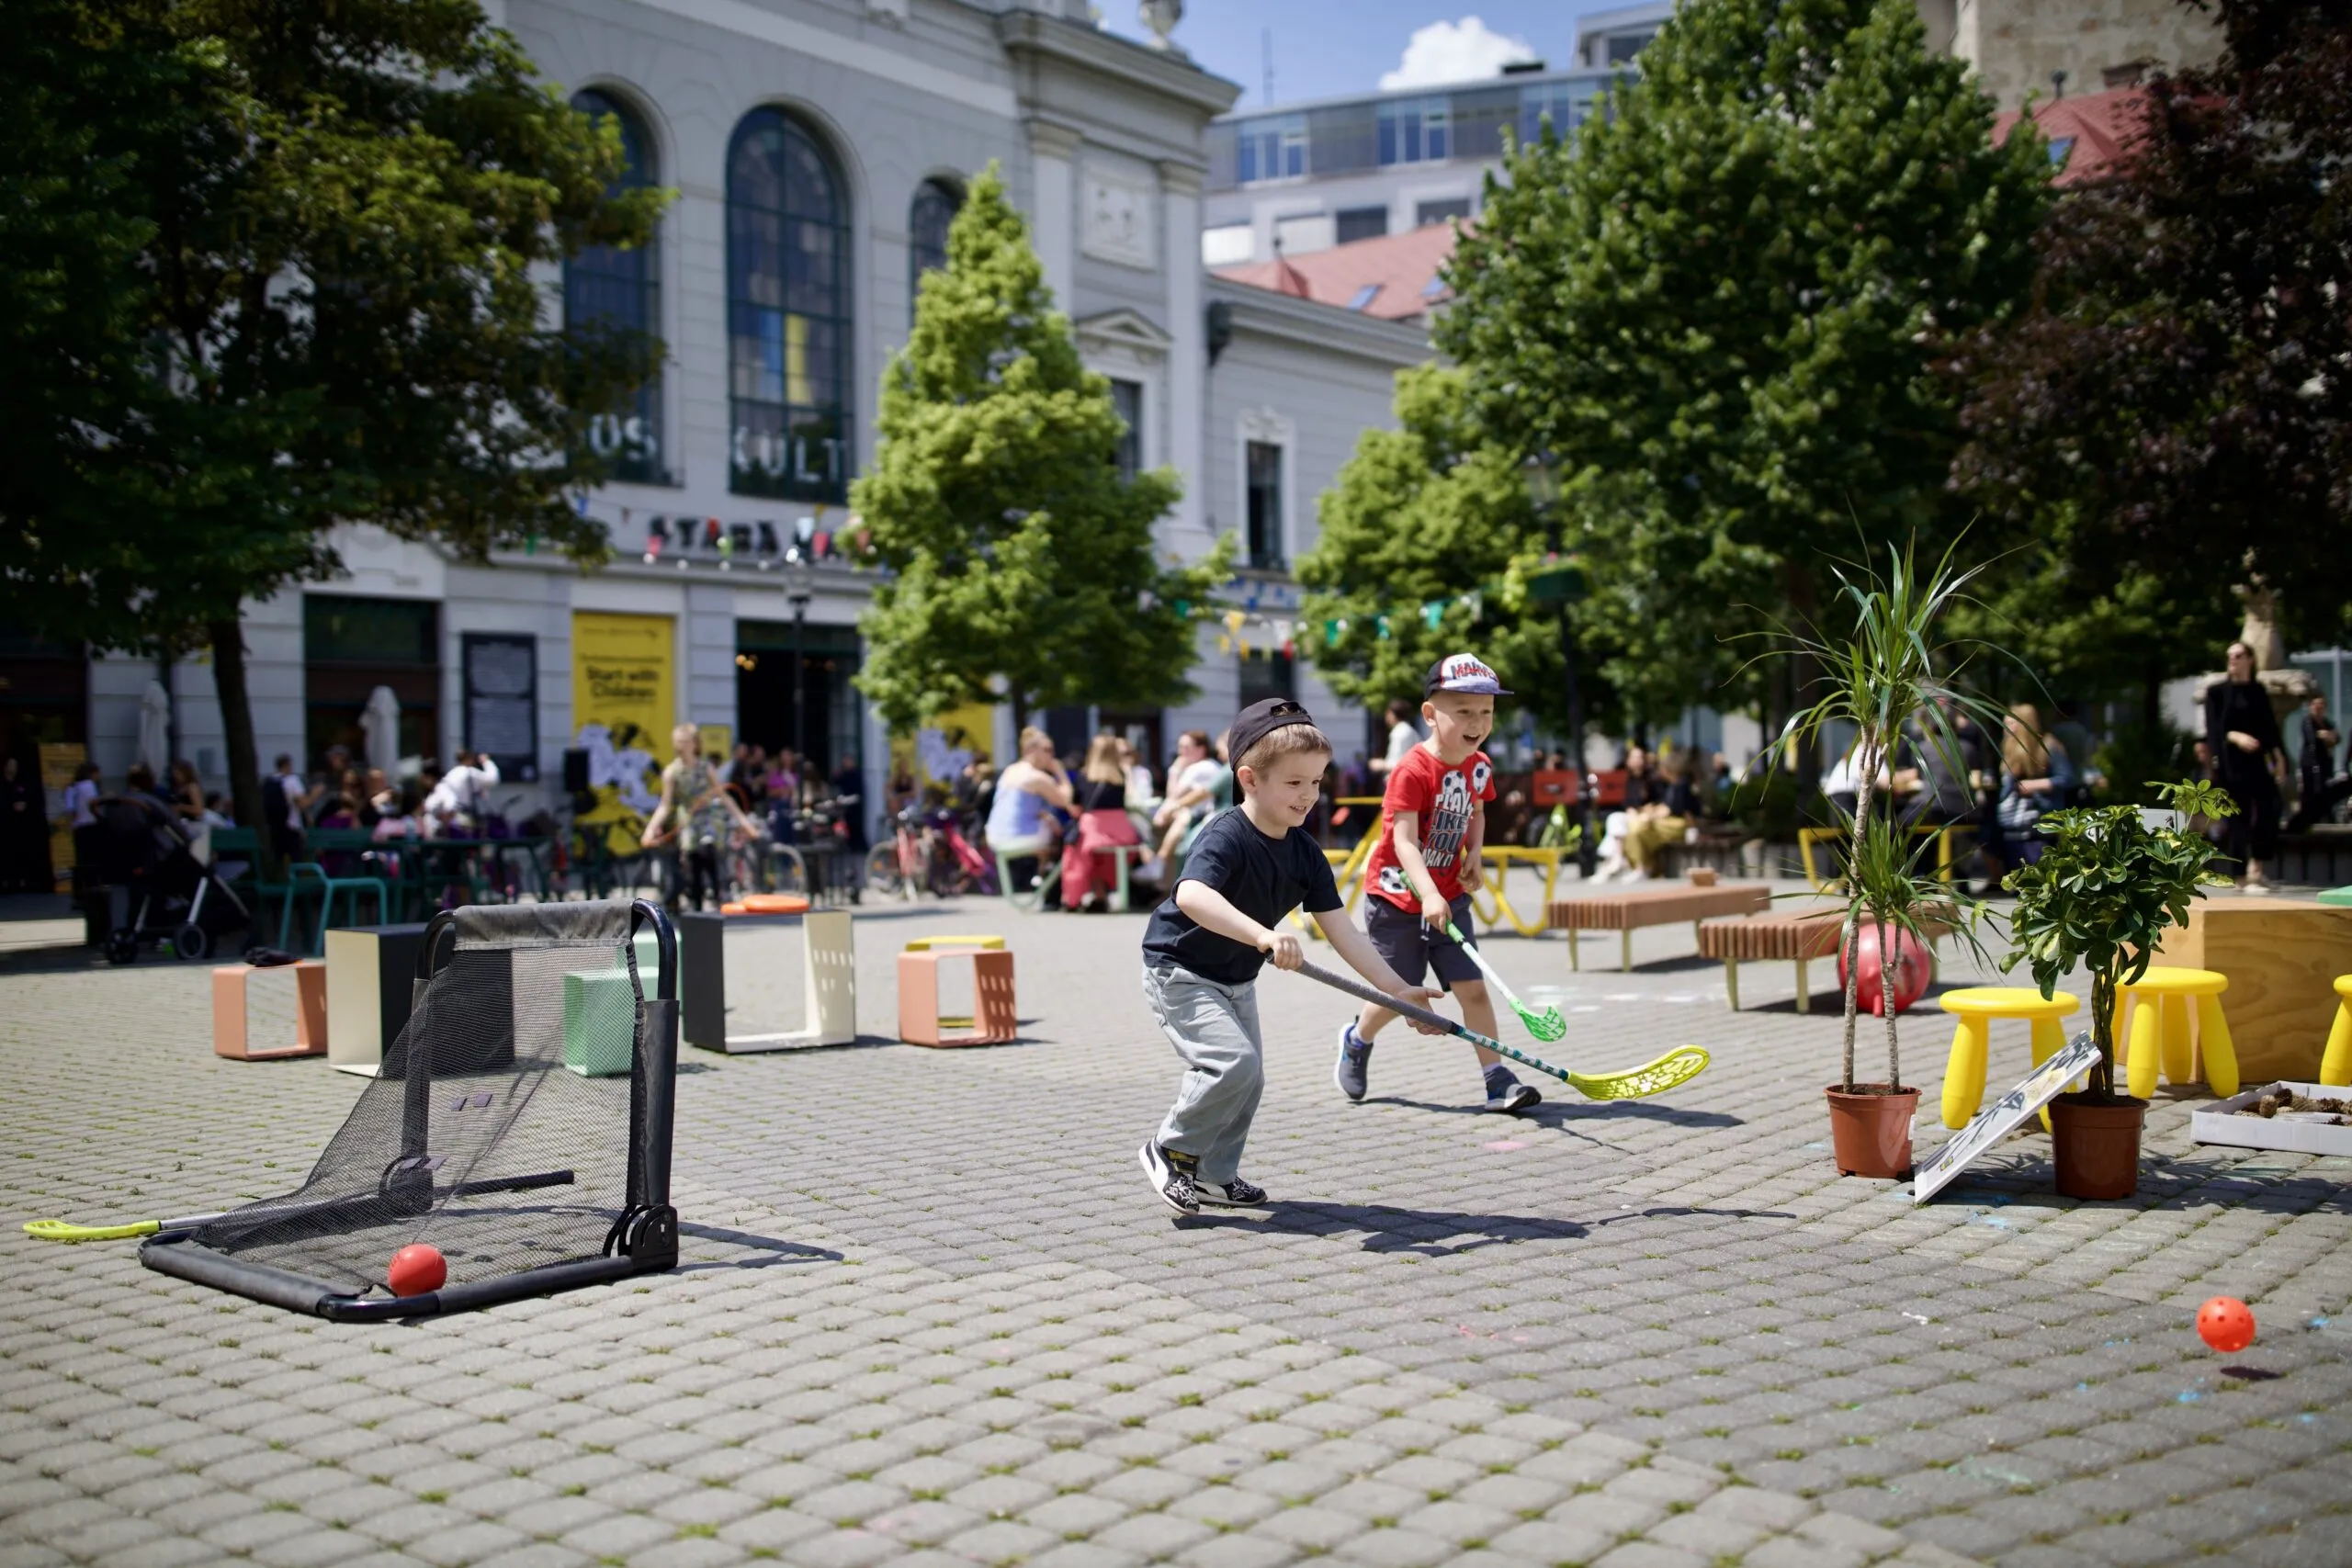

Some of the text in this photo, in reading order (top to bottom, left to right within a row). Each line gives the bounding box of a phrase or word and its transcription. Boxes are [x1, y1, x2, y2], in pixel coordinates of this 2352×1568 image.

[1435, 792, 1471, 816] PLAY
[1430, 807, 1468, 832] LIKE
[1426, 830, 1464, 855] YOU
